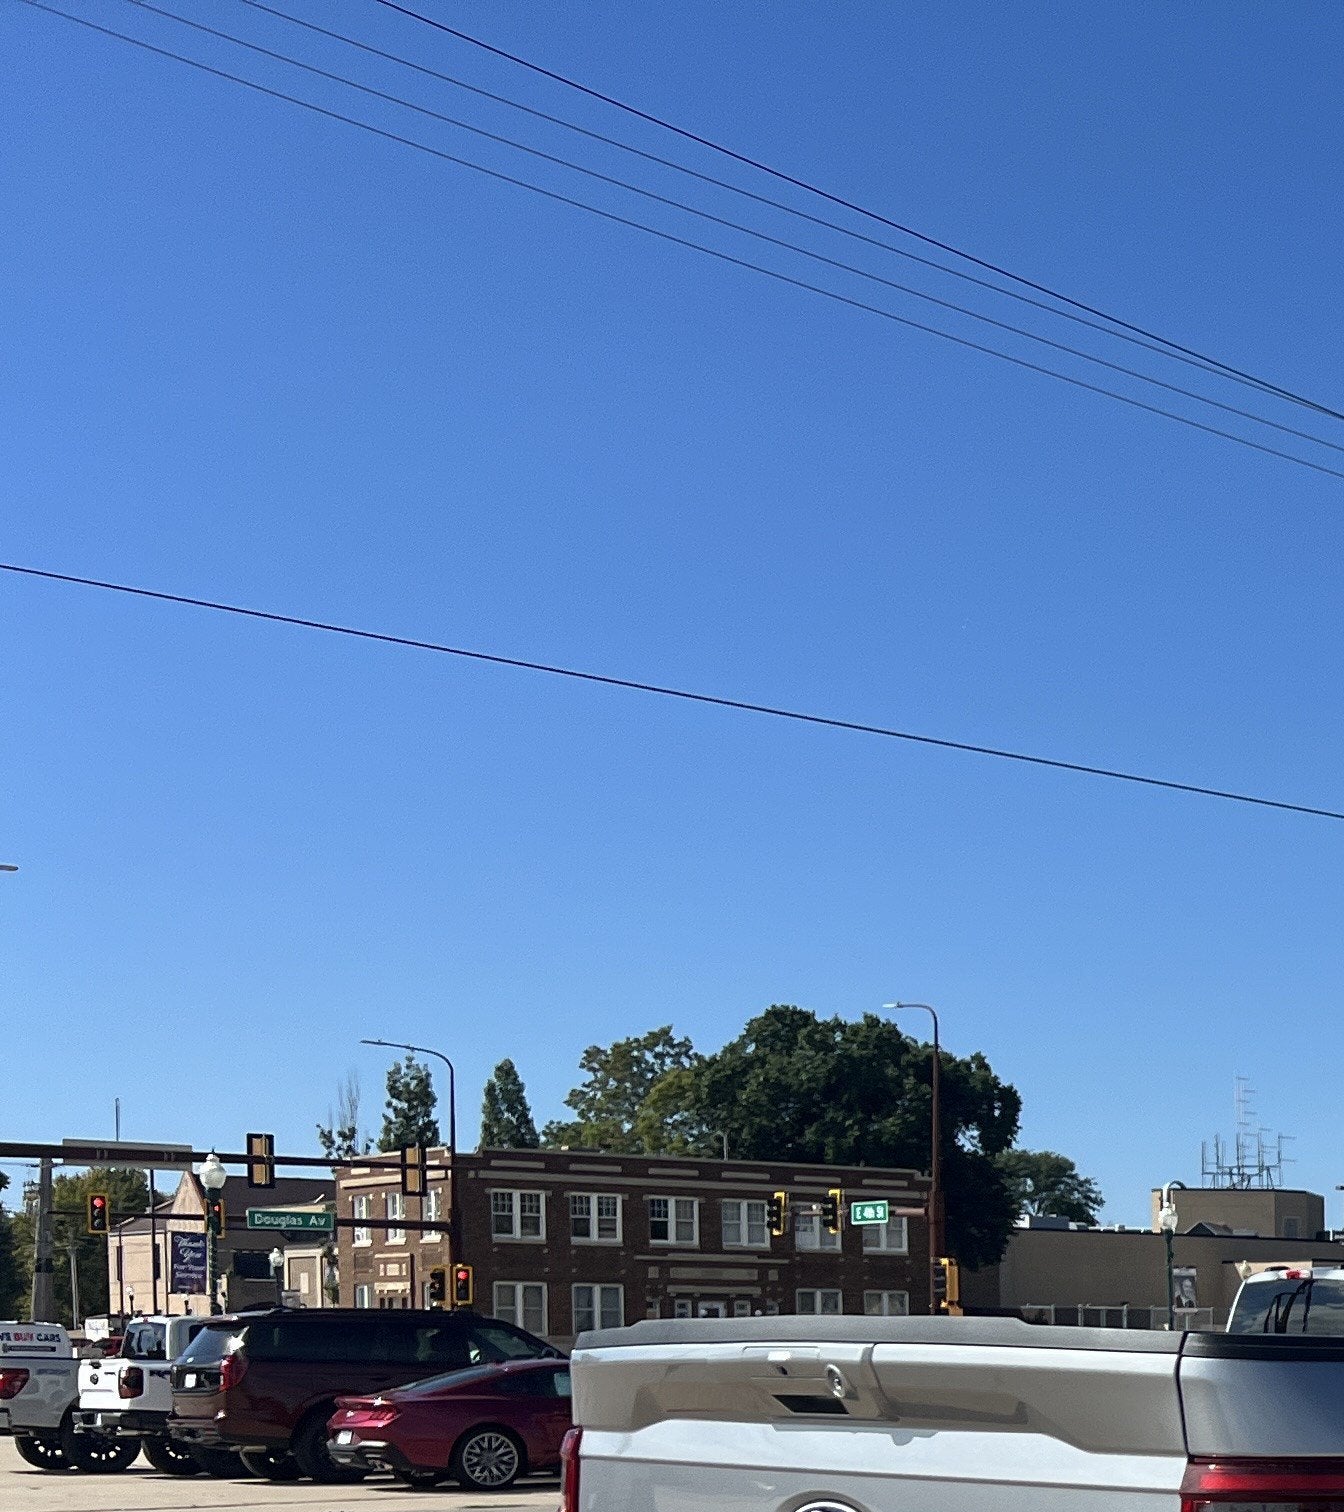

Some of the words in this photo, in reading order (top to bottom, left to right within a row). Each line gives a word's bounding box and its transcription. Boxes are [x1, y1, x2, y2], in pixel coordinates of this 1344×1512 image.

[855, 1206, 862, 1220] E
[254, 1213, 303, 1229] Douglas
[309, 1215, 326, 1227] Av
[13, 1332, 34, 1341] BUY
[36, 1333, 61, 1342] CARS
